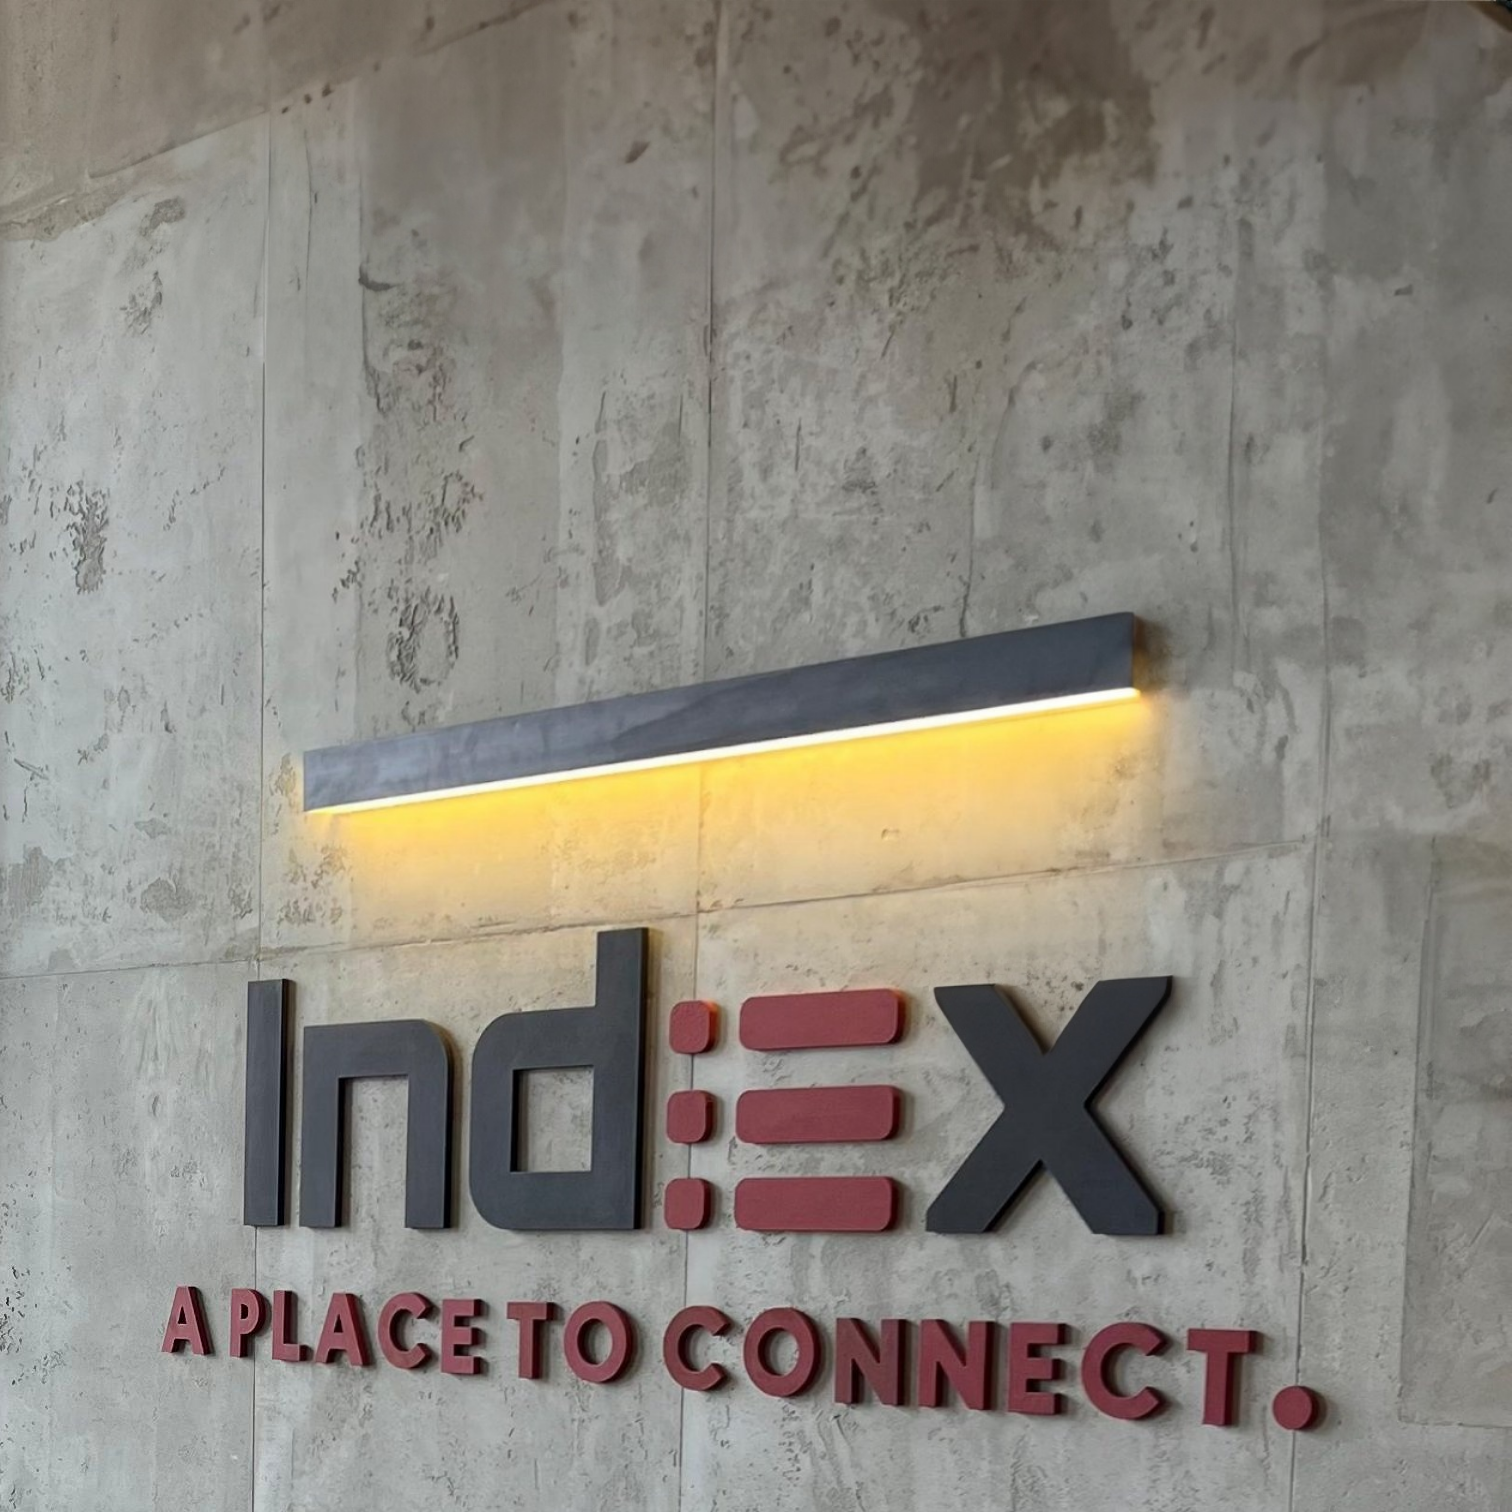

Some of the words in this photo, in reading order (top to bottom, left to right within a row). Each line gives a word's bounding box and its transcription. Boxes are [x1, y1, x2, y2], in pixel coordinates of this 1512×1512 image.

[161, 1286, 214, 1356] A
[230, 1288, 484, 1376] PLACE
[506, 1300, 634, 1384] TO
[662, 1305, 1326, 1431] CONNECT.
